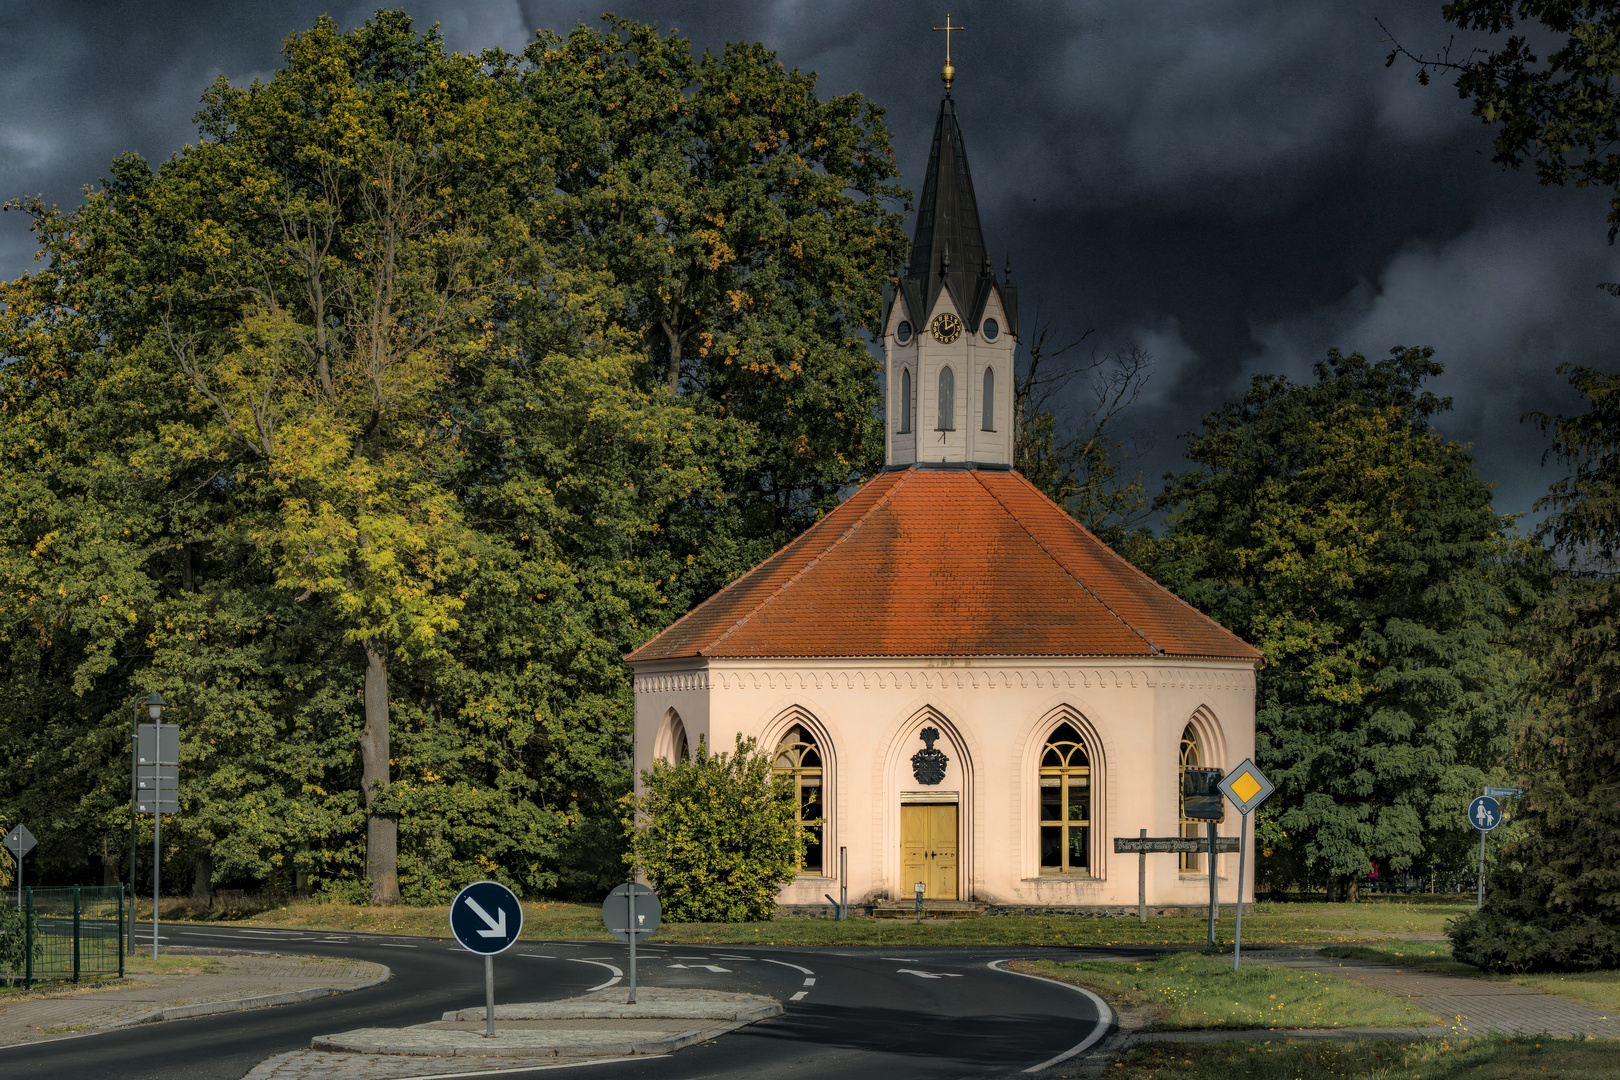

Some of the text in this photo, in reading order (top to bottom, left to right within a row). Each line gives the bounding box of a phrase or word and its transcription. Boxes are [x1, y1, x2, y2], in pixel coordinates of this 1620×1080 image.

[1118, 838, 1152, 850] Kirche
[1154, 841, 1170, 850] am
[1171, 838, 1198, 852] Weg
